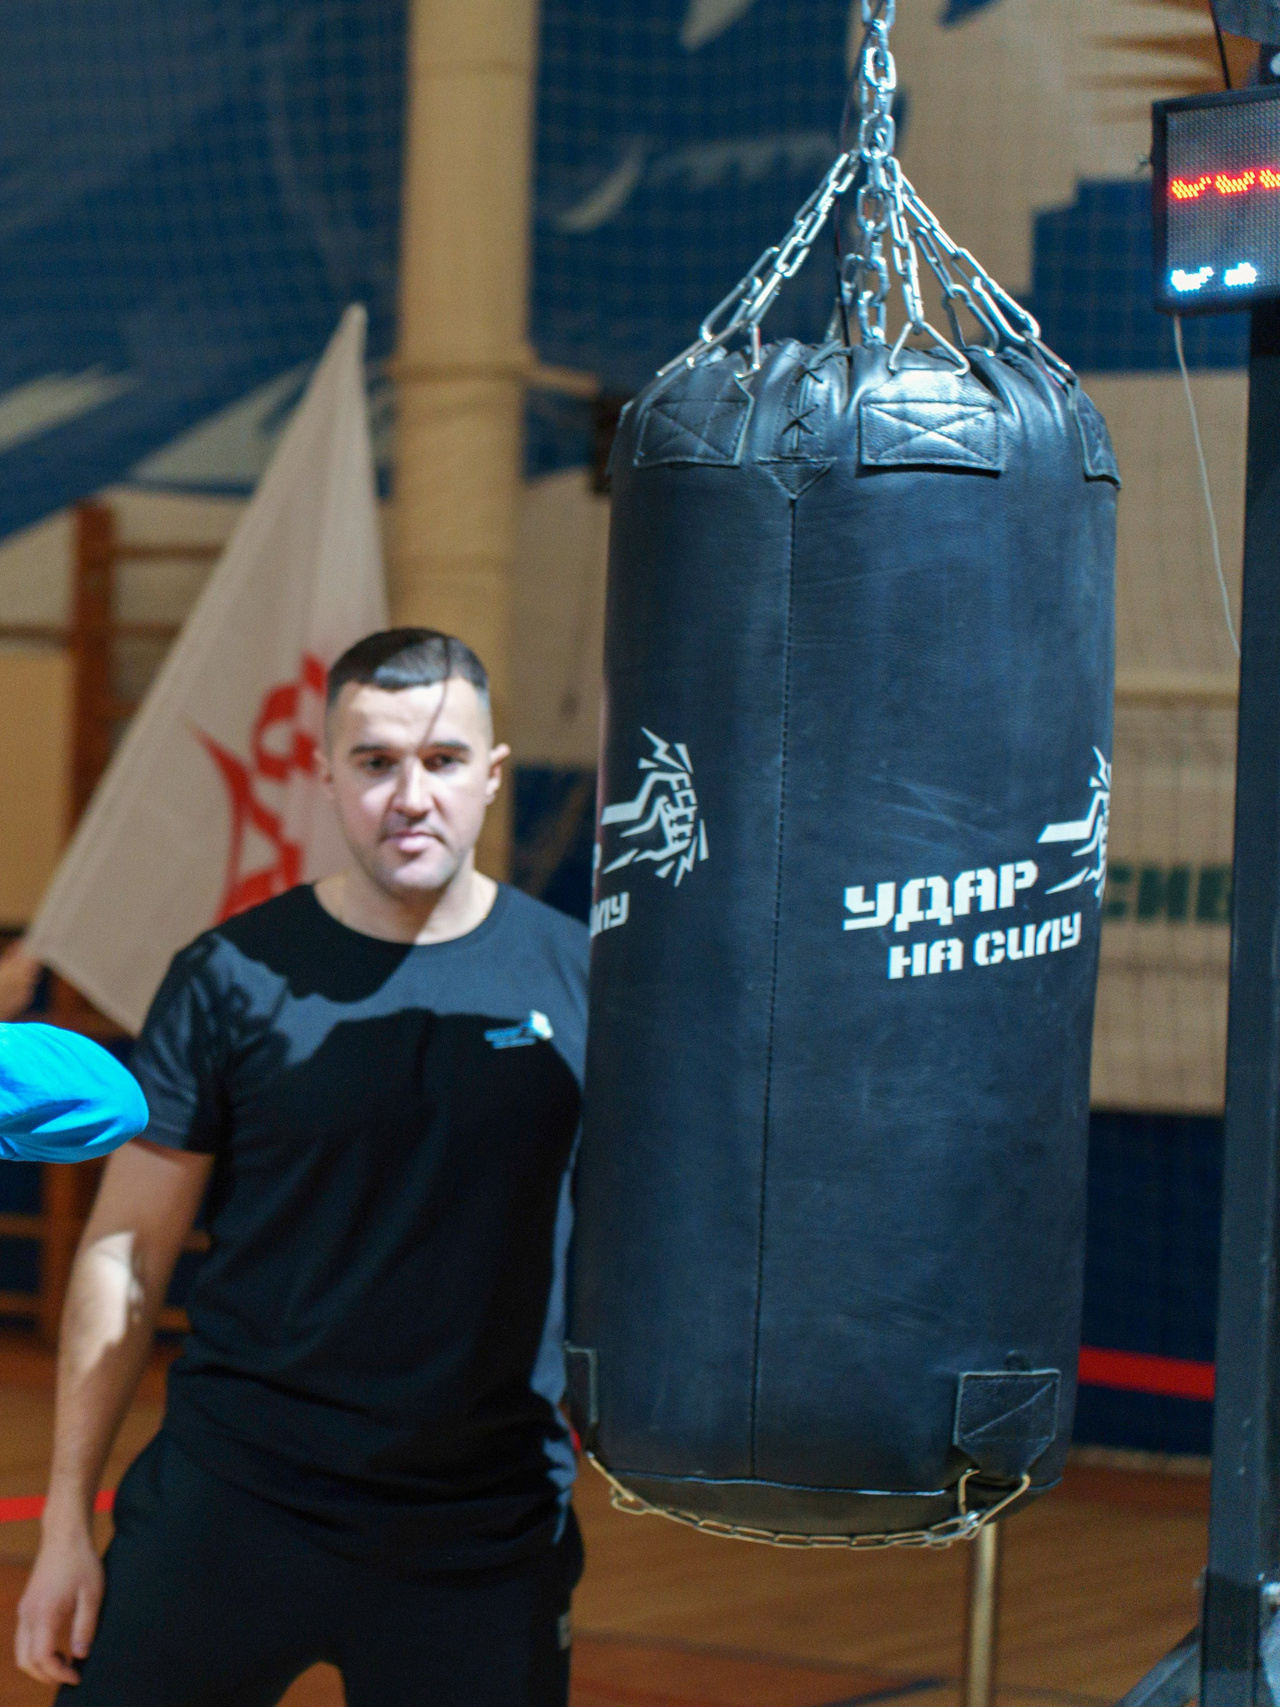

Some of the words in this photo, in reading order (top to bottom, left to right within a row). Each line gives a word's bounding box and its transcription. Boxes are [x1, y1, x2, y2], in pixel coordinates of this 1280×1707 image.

[842, 859, 1039, 933] УДАР
[887, 937, 964, 980] НА
[973, 911, 1082, 967] СИЛУ
